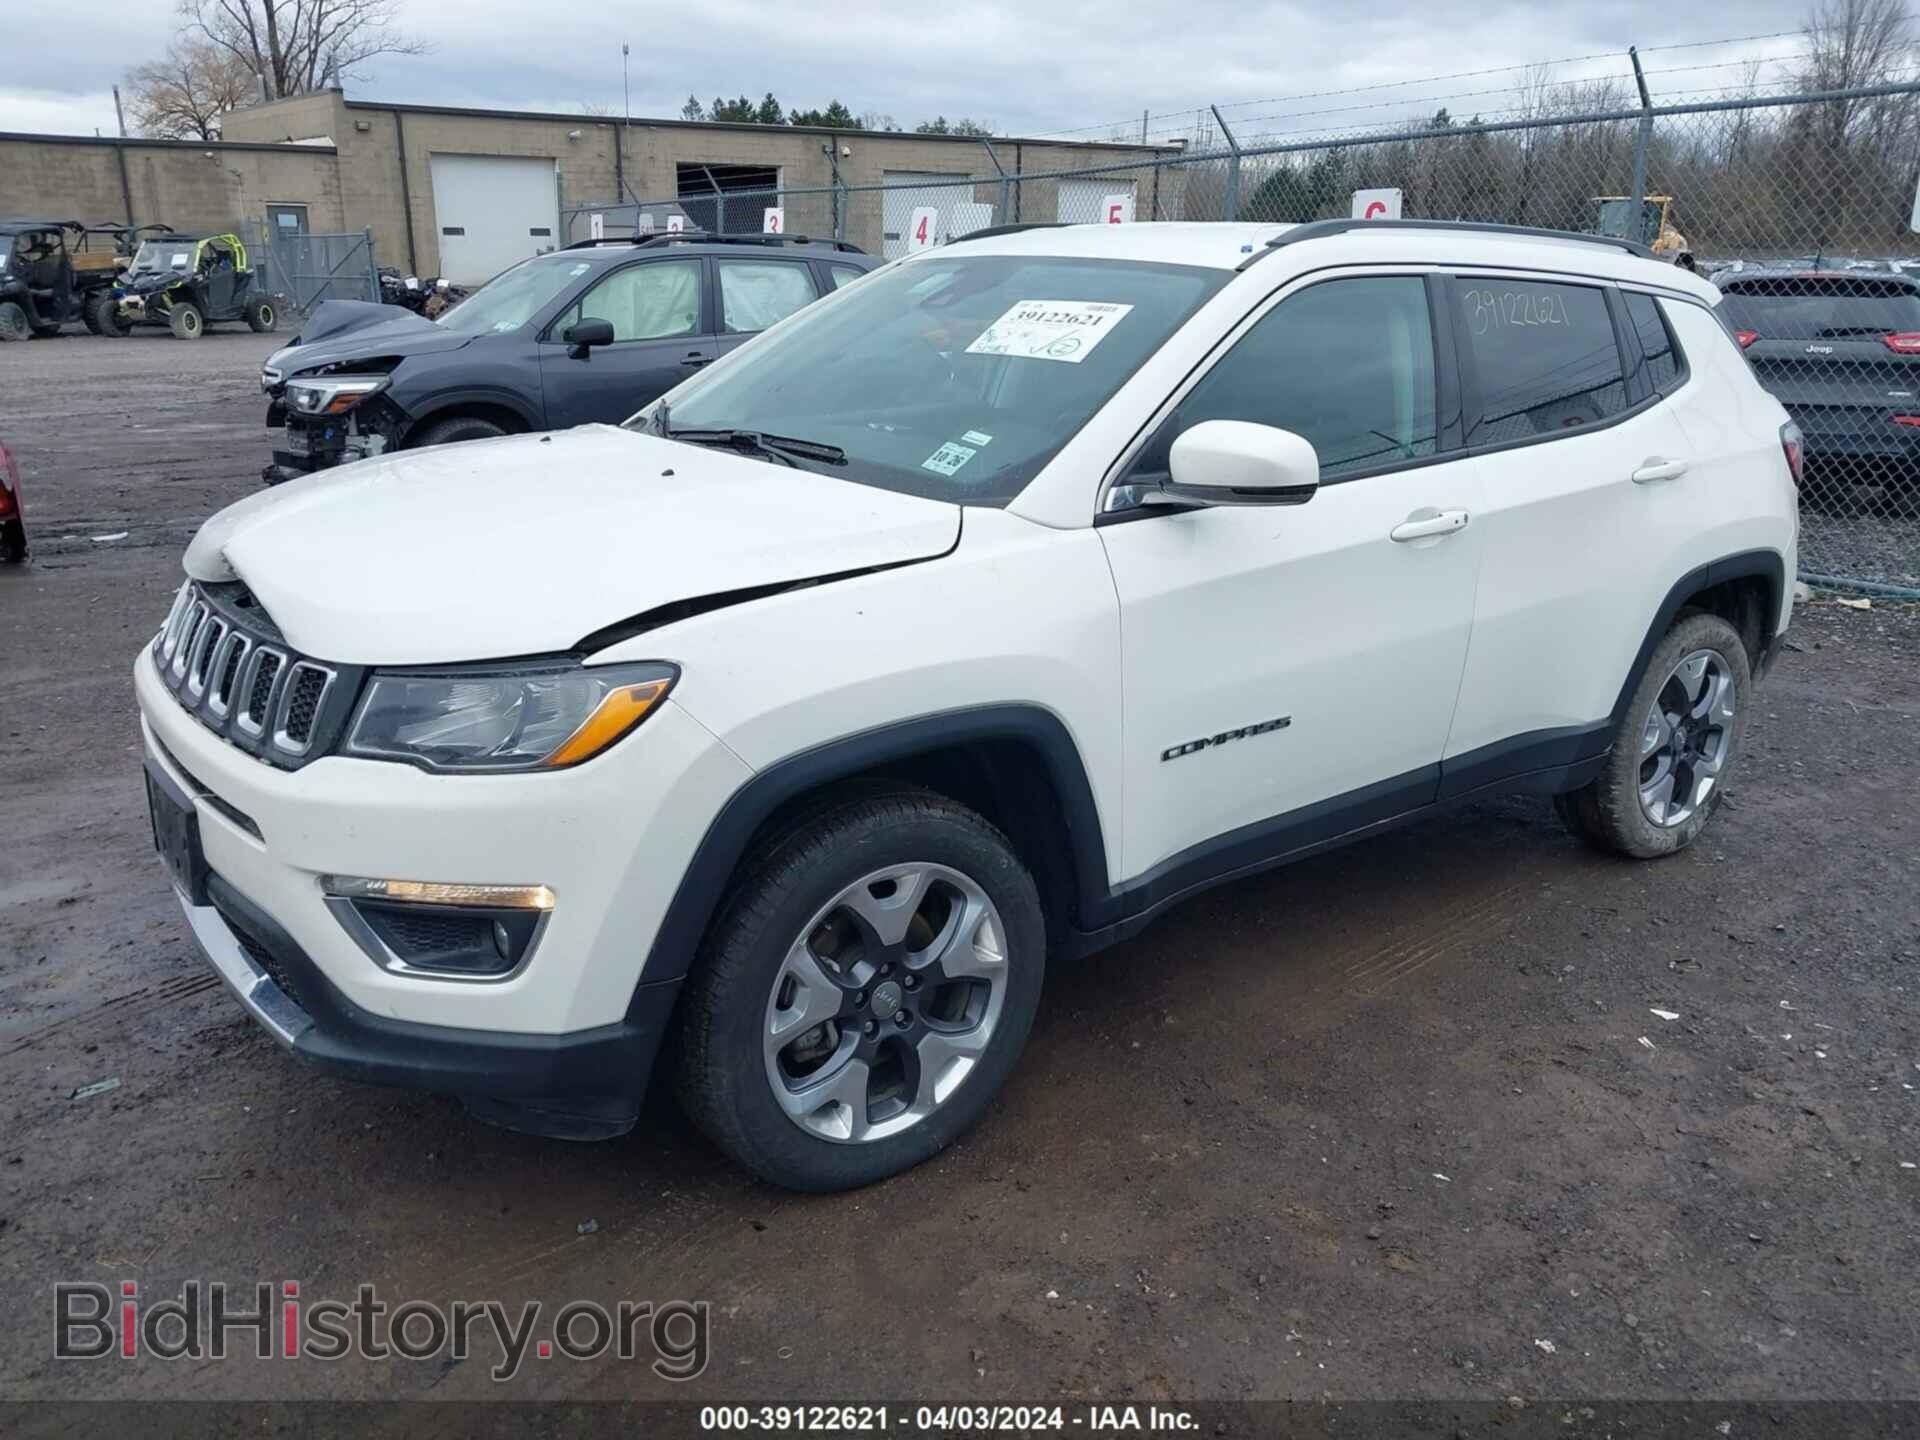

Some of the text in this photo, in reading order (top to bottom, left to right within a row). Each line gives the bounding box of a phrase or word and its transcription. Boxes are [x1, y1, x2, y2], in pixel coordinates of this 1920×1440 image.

[1108, 205, 1122, 224] 5
[916, 216, 928, 245] 4
[1464, 289, 1570, 335] 39122621
[1806, 344, 1833, 354] Jeep
[1161, 715, 1292, 762] COMPASS
